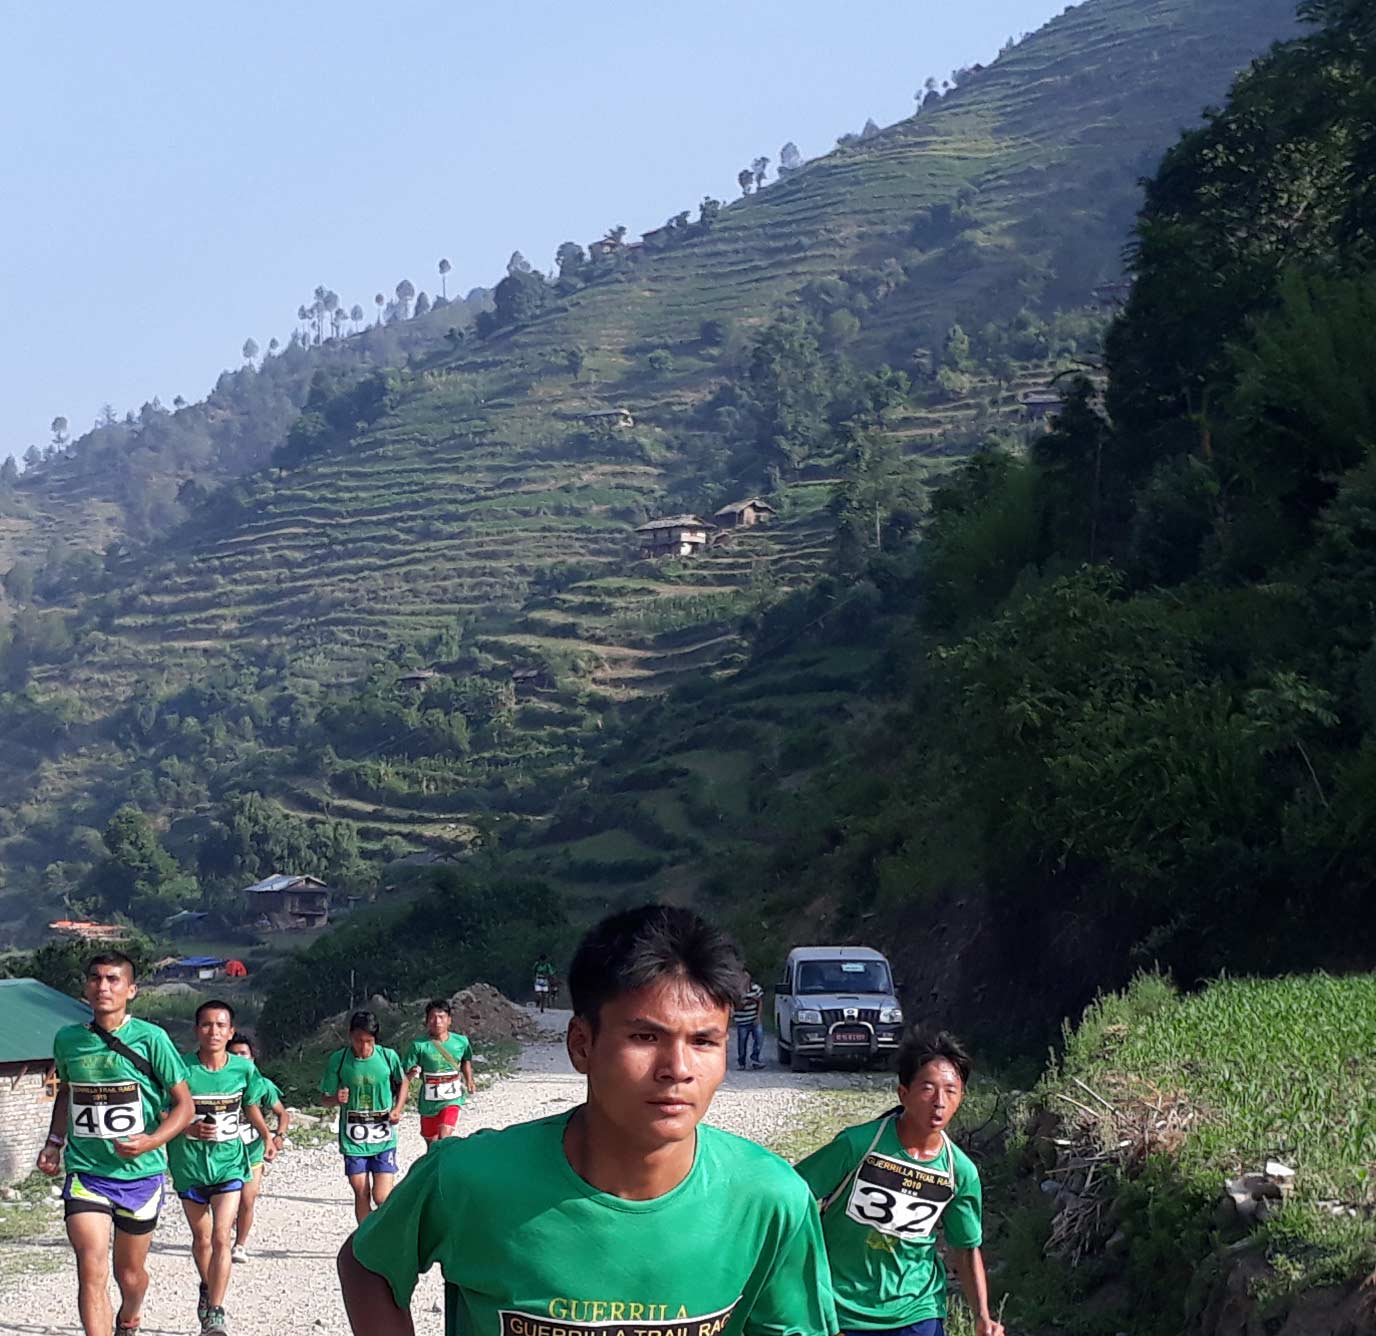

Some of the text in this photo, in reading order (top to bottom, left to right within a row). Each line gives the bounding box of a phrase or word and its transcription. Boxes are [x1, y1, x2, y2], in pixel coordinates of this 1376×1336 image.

[430, 1083, 456, 1098] 14
[75, 1106, 136, 1133] 46
[221, 1113, 239, 1135] 3
[350, 1123, 389, 1140] 03
[867, 1157, 913, 1177] GUERRILLA
[915, 1171, 936, 1184] TRAIL
[855, 1187, 938, 1233] 32
[549, 1298, 688, 1322] GUERRILA
